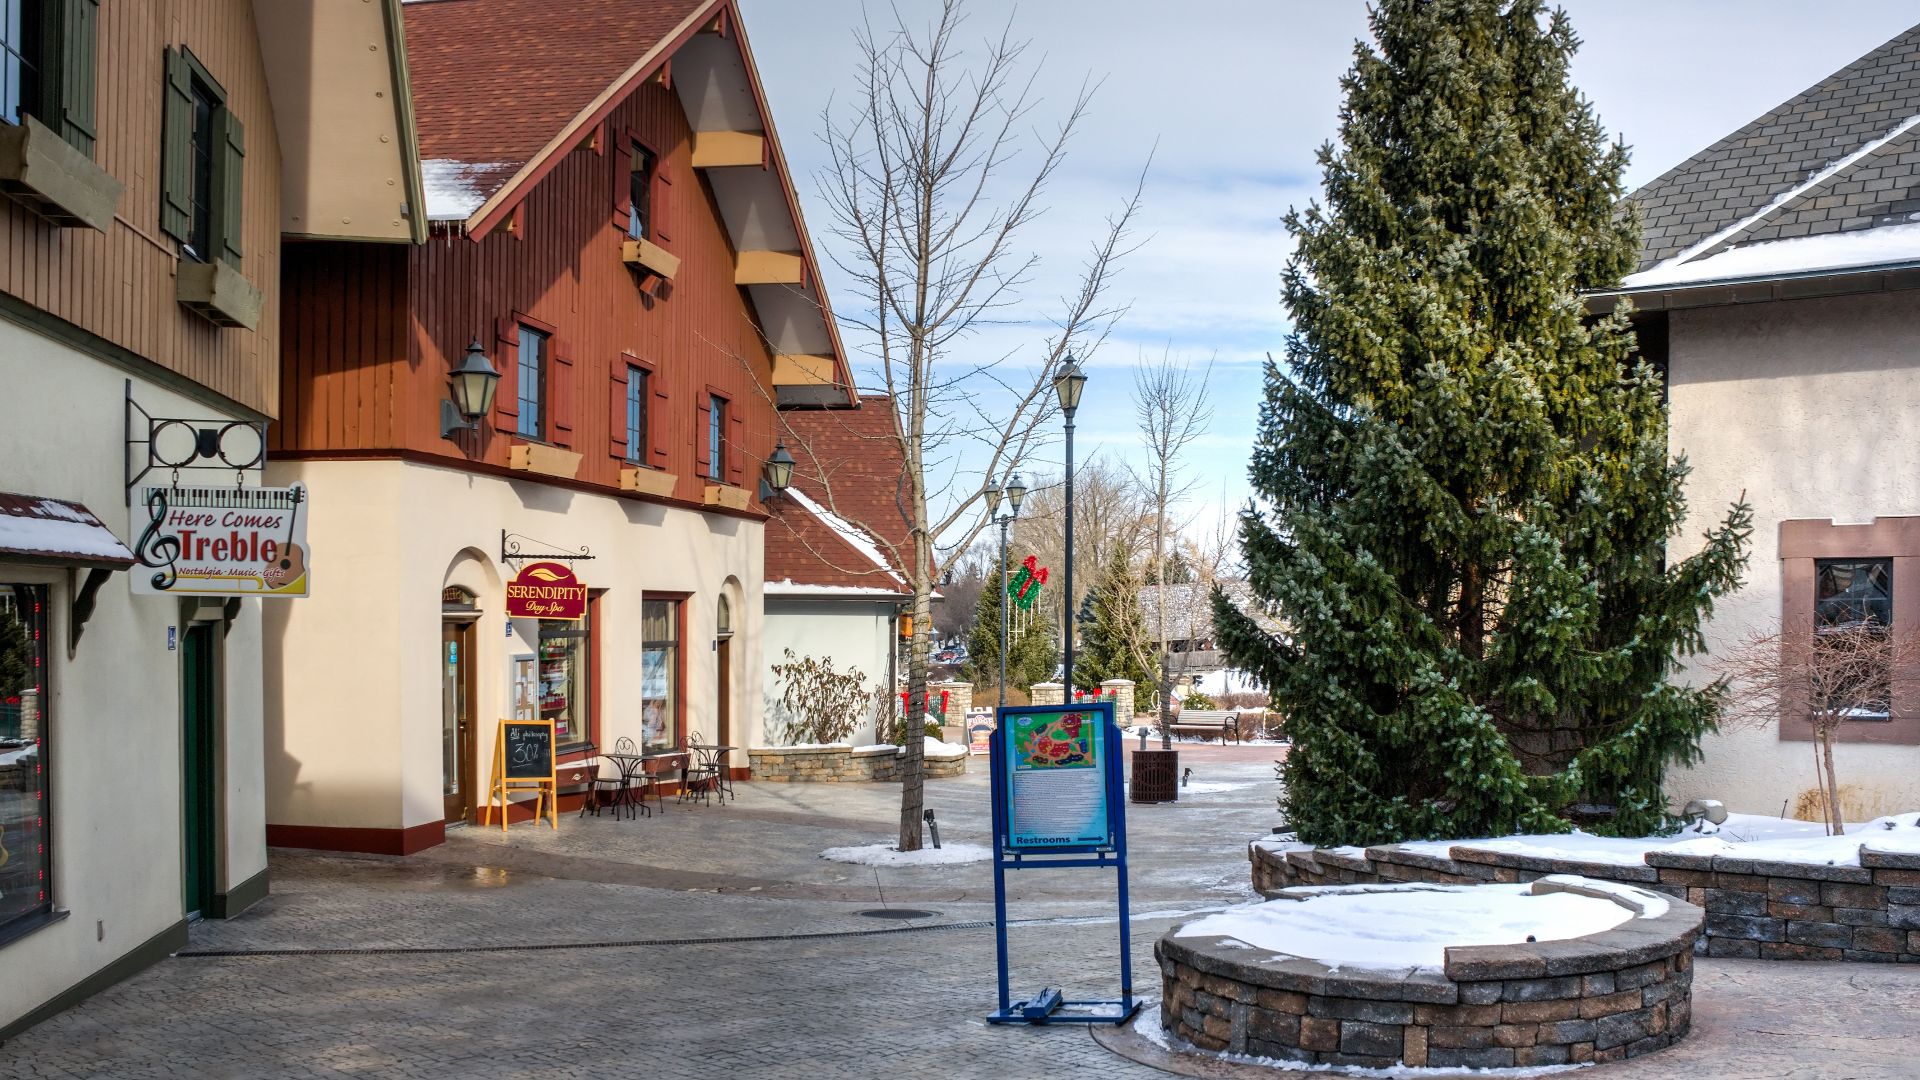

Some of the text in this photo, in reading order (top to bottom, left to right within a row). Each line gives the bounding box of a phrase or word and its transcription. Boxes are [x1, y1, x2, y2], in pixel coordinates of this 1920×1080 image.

[168, 510, 283, 528] Here Comes
[177, 530, 277, 563] Treble
[178, 567, 285, 581] Nostalgia Music Gifts
[507, 585, 584, 600] SERENDIPITY
[525, 601, 565, 615] Day Spa
[512, 743, 539, 763] 30%
[1016, 836, 1071, 844] Restrooms
